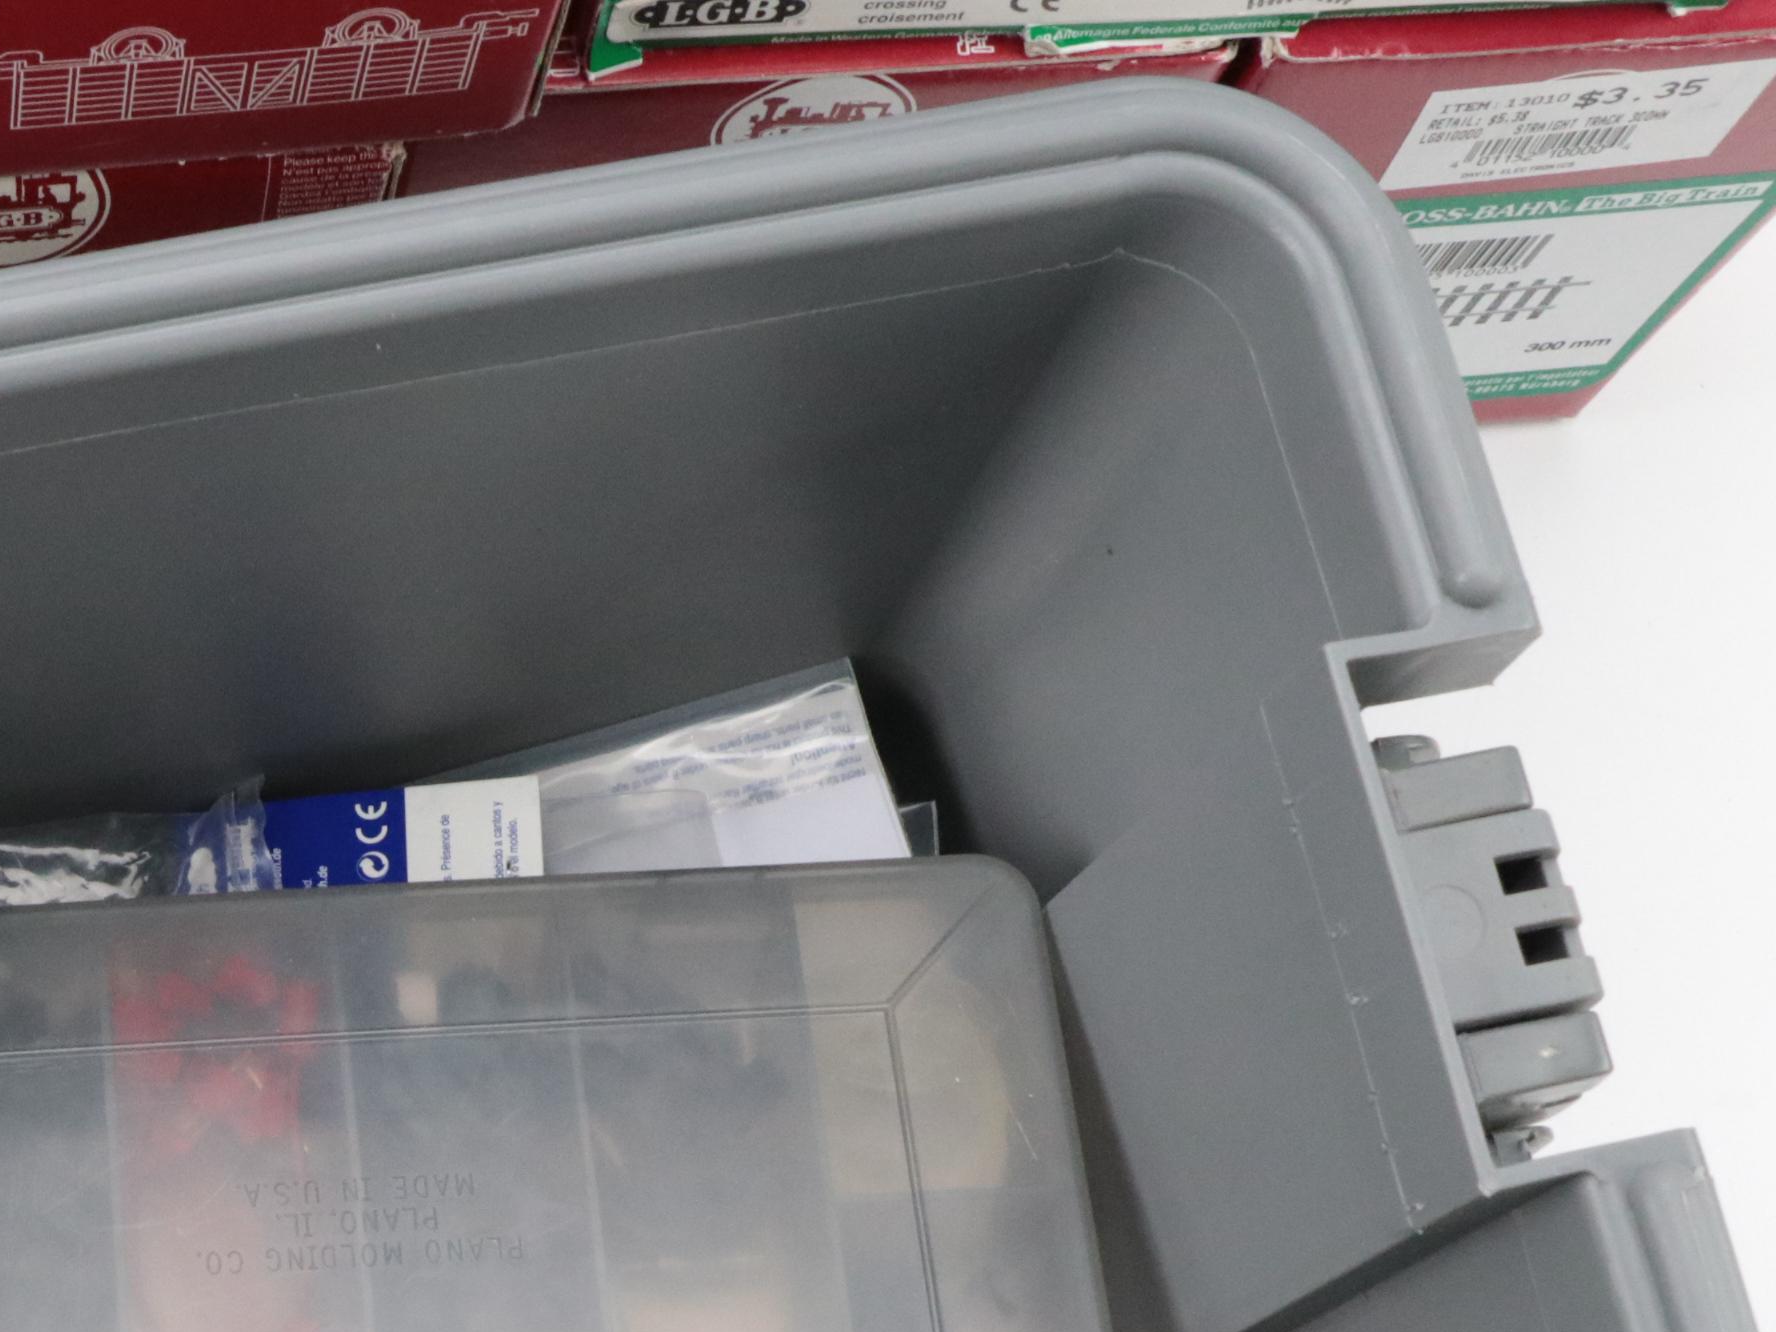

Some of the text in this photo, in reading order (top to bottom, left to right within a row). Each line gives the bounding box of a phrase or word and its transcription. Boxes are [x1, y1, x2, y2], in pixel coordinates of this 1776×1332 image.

[858, 11, 965, 25] croisement
[1507, 92, 1570, 107] 13010
[1427, 116, 1481, 129] RETAIL:
[1513, 119, 1578, 134] STRAIGHT
[1585, 114, 1623, 126] TRACK
[1585, 193, 1629, 210] The
[1635, 189, 1679, 209] Big
[1687, 182, 1762, 202] Train
[1524, 337, 1613, 353] 300 mm
[439, 814, 450, 825] de
[491, 808, 504, 838] cantos
[236, 1170, 475, 1209] MADE IN U.S.A.
[195, 1232, 522, 1277] PLANO MOLDING CO.
